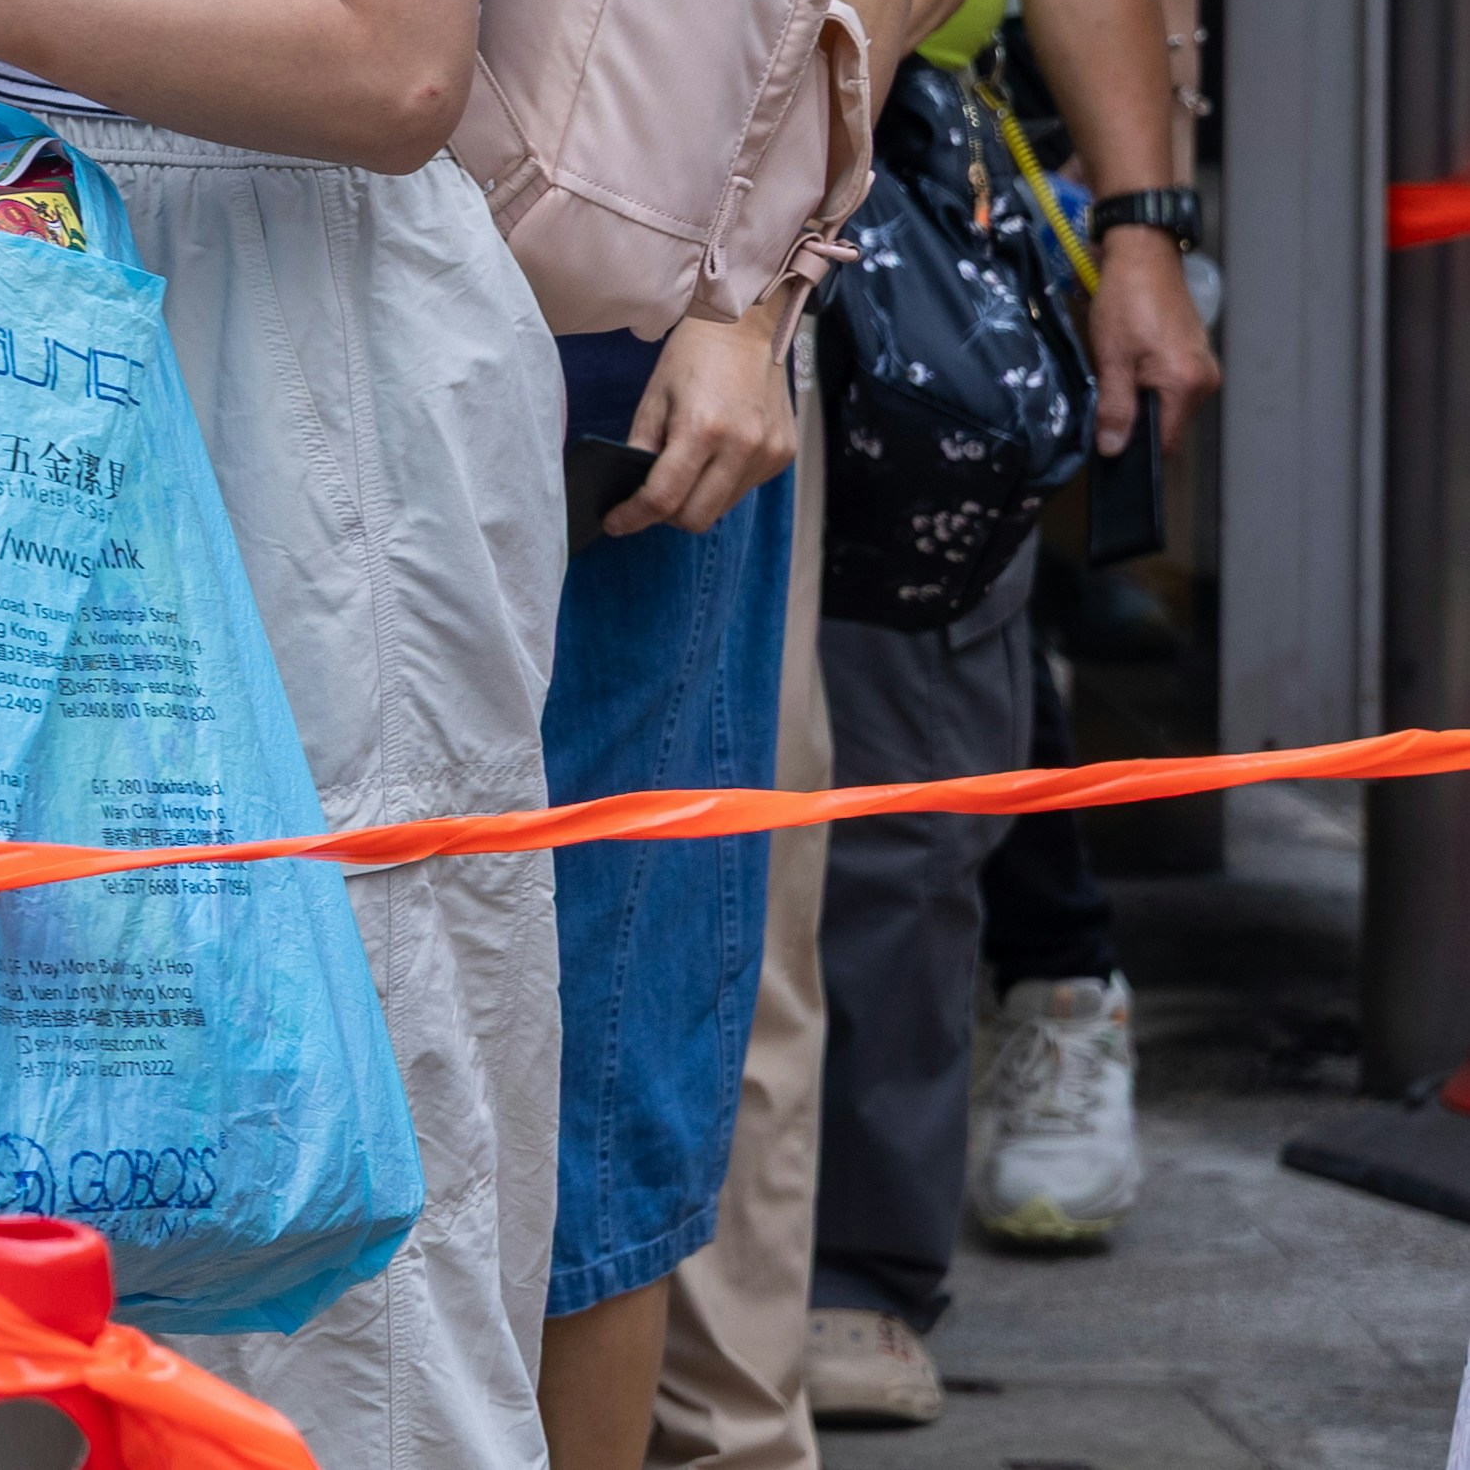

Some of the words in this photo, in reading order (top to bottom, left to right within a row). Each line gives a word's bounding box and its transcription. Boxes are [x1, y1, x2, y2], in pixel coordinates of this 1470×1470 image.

[74, 496, 88, 515] &
[118, 779, 142, 795] 280
[167, 959, 194, 978] Hop
[122, 985, 156, 1005] Hong
